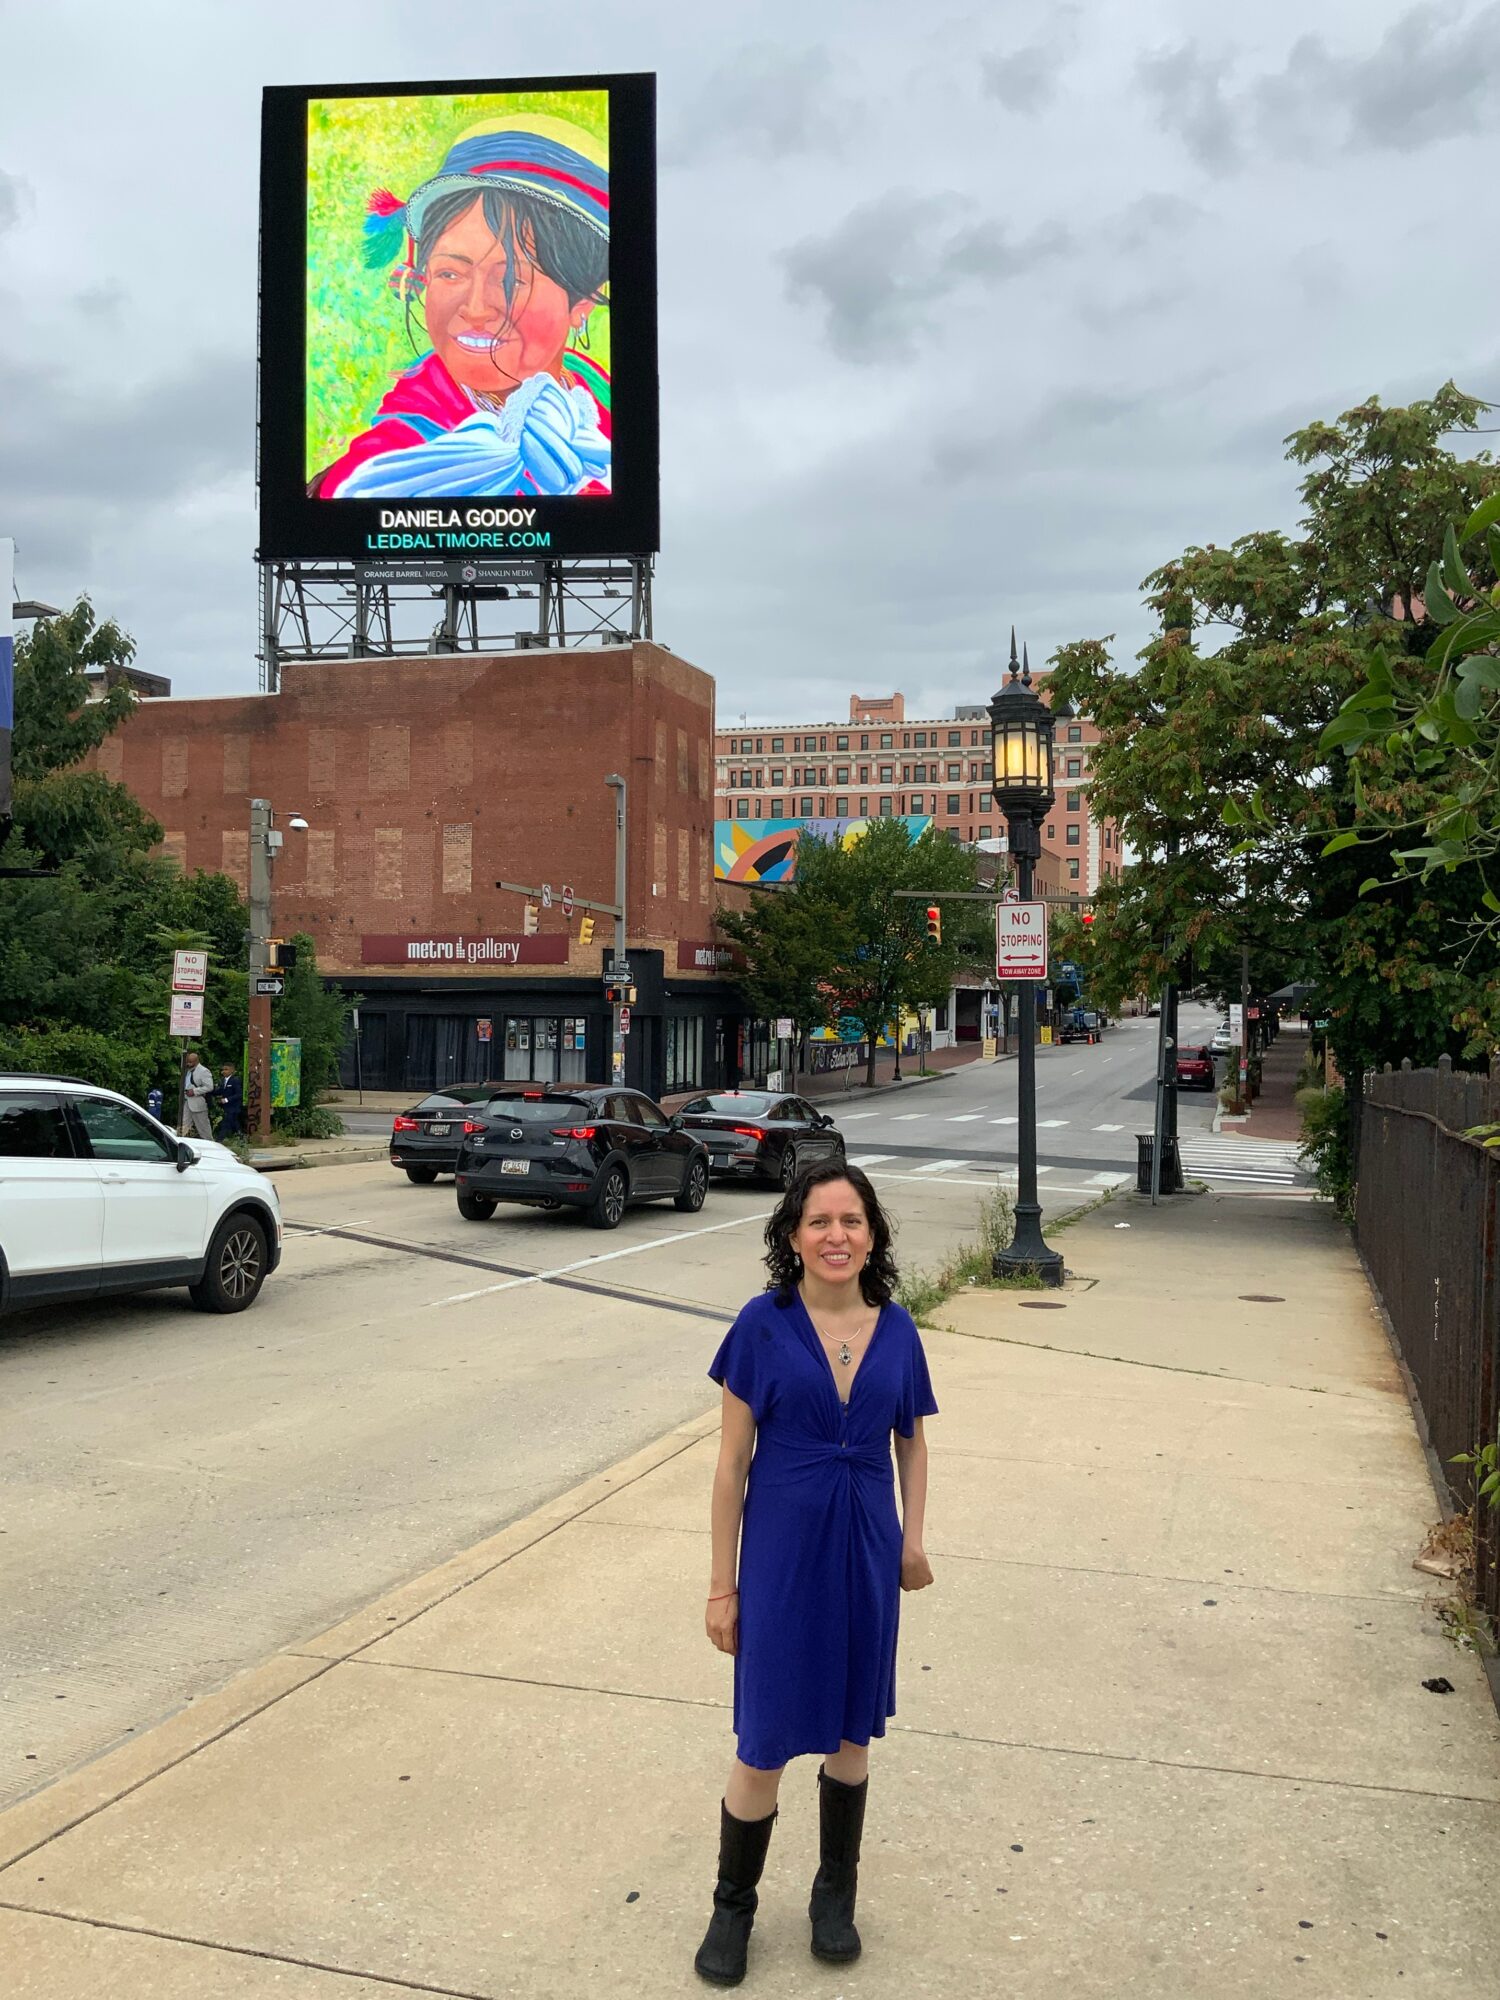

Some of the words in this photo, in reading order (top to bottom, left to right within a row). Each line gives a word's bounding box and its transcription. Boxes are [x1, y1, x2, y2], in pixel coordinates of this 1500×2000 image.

[381, 510, 462, 528] DANIELA
[466, 508, 536, 526] GODOY
[368, 532, 550, 548] LEDBALTIMORE.COM
[1012, 912, 1030, 925] NO
[1001, 934, 1042, 947] STOPPING
[407, 940, 453, 959] metro
[468, 938, 520, 963] gallery
[185, 956, 197, 964] NO
[177, 967, 203, 975] STOPPING
